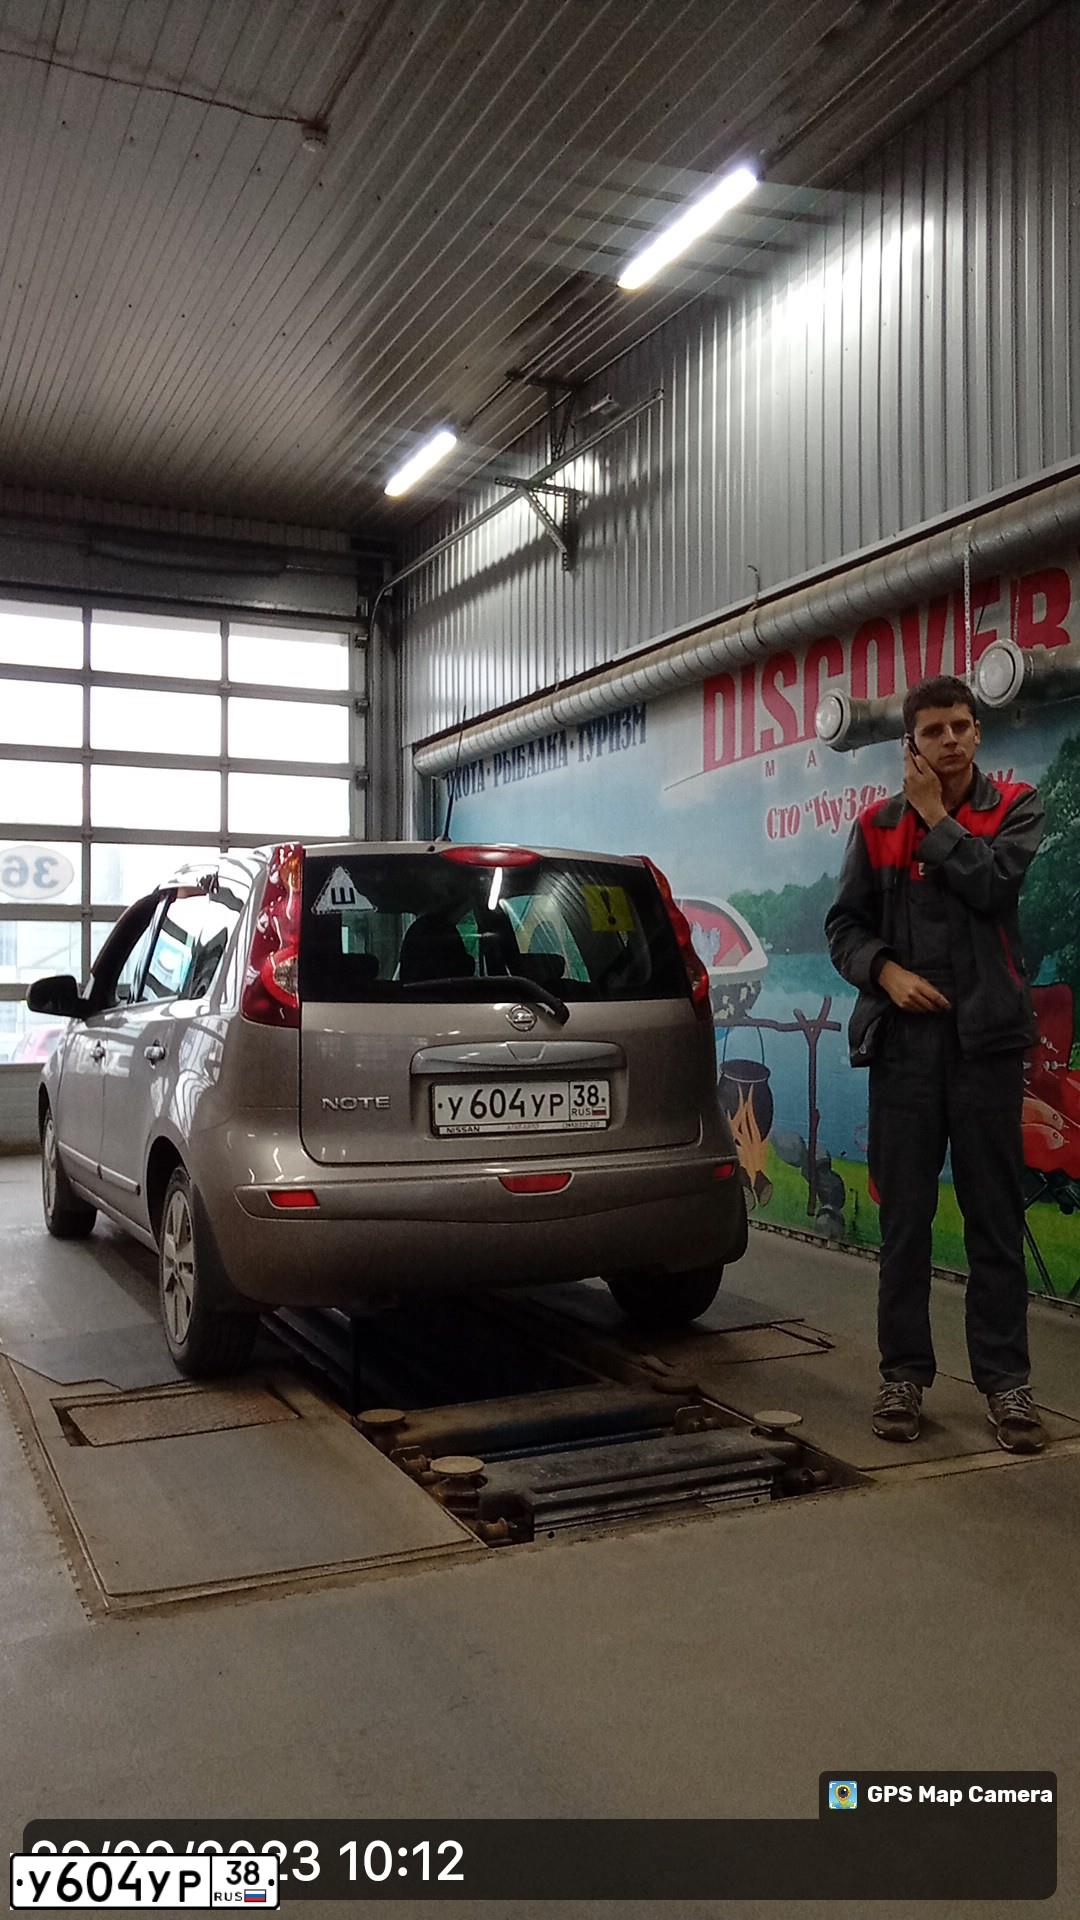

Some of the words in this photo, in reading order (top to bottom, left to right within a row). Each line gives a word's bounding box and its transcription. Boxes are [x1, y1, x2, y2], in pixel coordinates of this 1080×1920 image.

[703, 568, 1071, 772] DISCOVER
[493, 729, 568, 787] РЫБАЛКА
[577, 702, 647, 762] ТУРИЗМ
[331, 887, 356, 905] Ш
[321, 1096, 391, 1111] NOTE
[573, 1085, 600, 1107] 38
[572, 1107, 592, 1116] RUS
